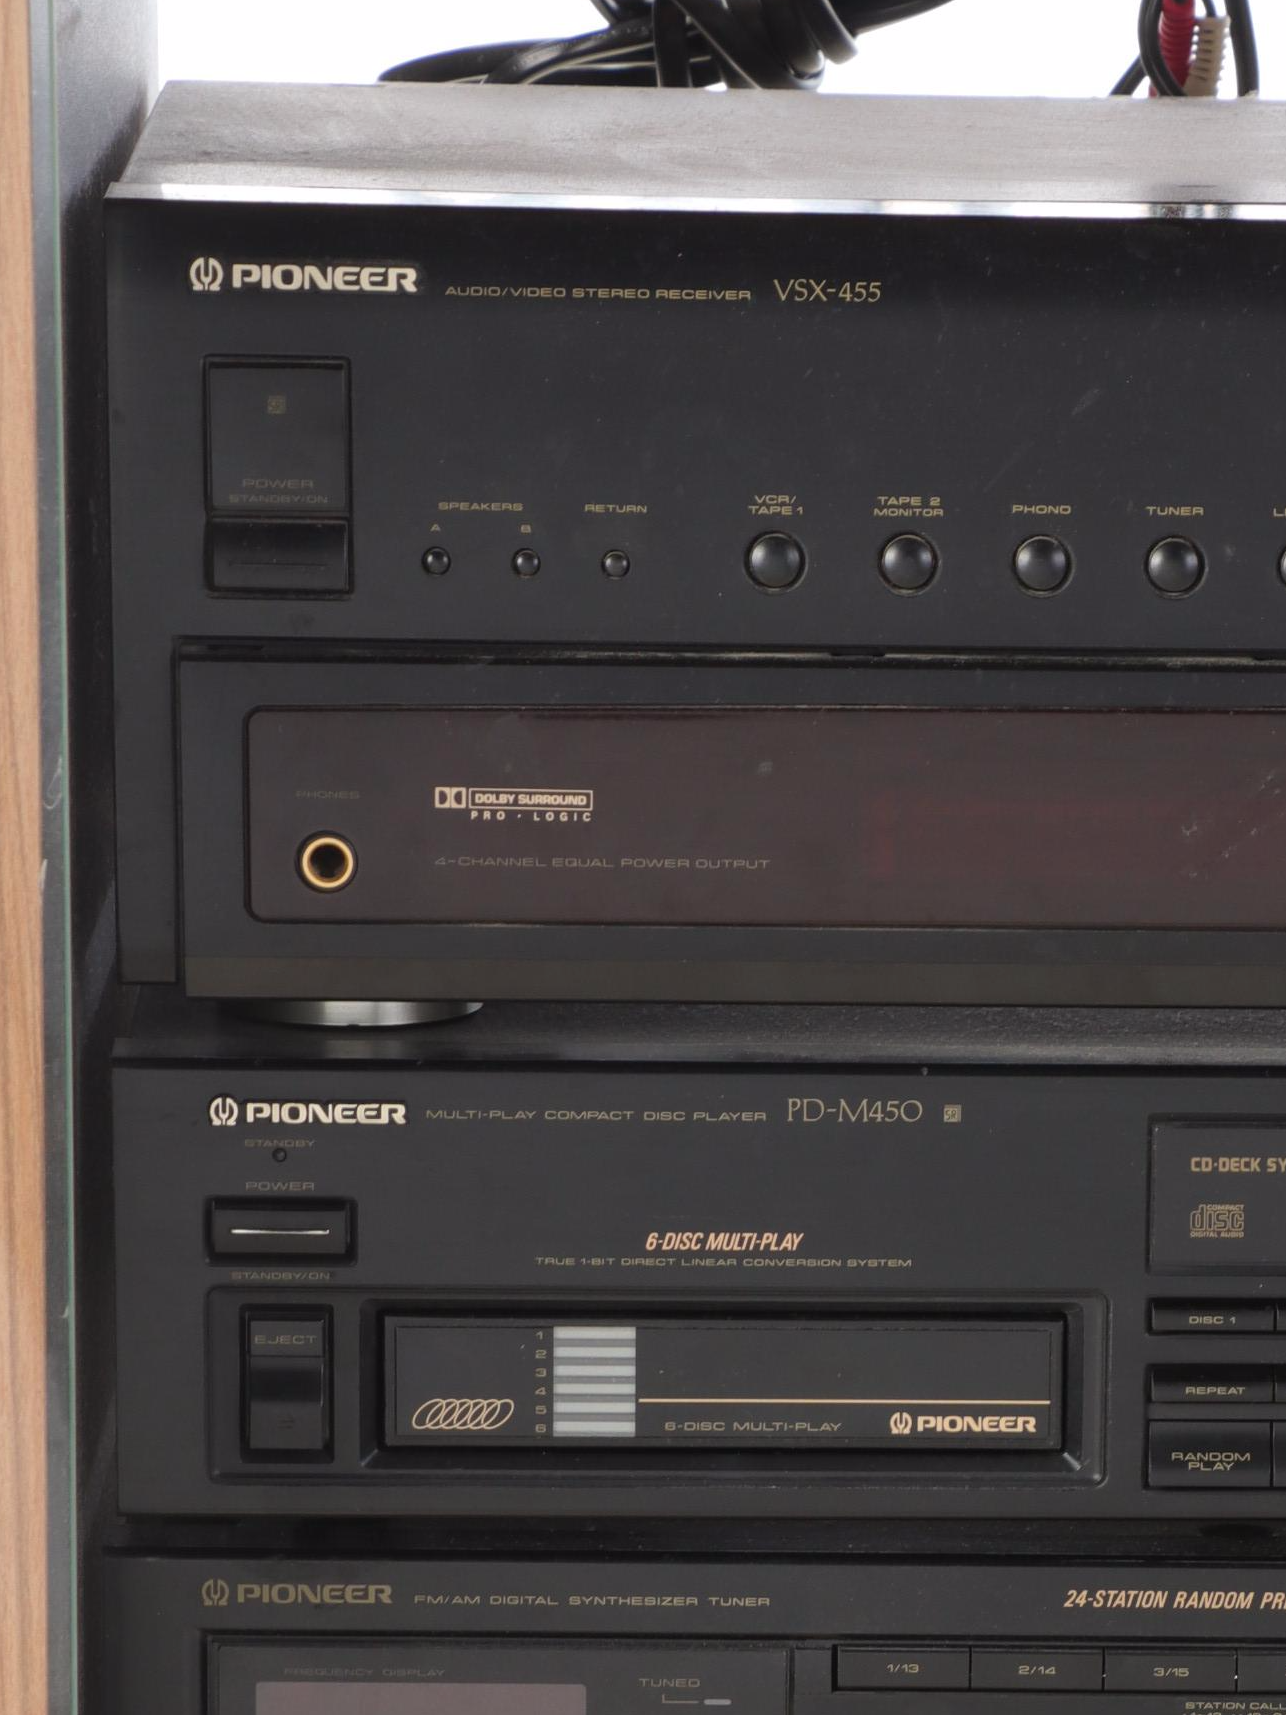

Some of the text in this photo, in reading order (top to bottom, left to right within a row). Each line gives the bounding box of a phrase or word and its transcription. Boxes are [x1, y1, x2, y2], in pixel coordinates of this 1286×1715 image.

[232, 264, 418, 292] PIONEER
[444, 286, 752, 301] AUDIO/VIDEO STEREO RECEIVER
[773, 278, 882, 303] VSX-455
[438, 501, 524, 512] SPEAKERS
[877, 496, 922, 506] TAPE
[584, 503, 648, 513] RETURN
[748, 505, 793, 516] TAPE
[873, 507, 944, 517] MONITOR
[1011, 504, 1072, 515] PHONO
[1145, 506, 1204, 516] TUNER
[474, 793, 587, 806] DOLBY SURROUND
[246, 1102, 406, 1125] PIONEER
[425, 1109, 767, 1122] MULTI-PLAY COMPACT DISC PLAYER
[787, 1098, 923, 1123] PD-M450
[645, 1231, 805, 1251] 6-DISC MULTI-PLAY
[535, 1256, 912, 1268] TRUE DIRECT LINEAR CONVERSION SYSTEM
[1188, 1315, 1224, 1325] DISC
[1185, 1386, 1246, 1396] REPEAT
[916, 1415, 1037, 1433] PIONEER
[1171, 1451, 1251, 1462] RANDOM
[1188, 1461, 1235, 1472] PLAY
[237, 1583, 393, 1604] PIONEER
[1063, 1589, 1169, 1609] 24-STATION
[1172, 1590, 1255, 1609] RANDOM
[414, 1595, 770, 1607] FM/AM DIGITAL SYNTHESIZER TUNER
